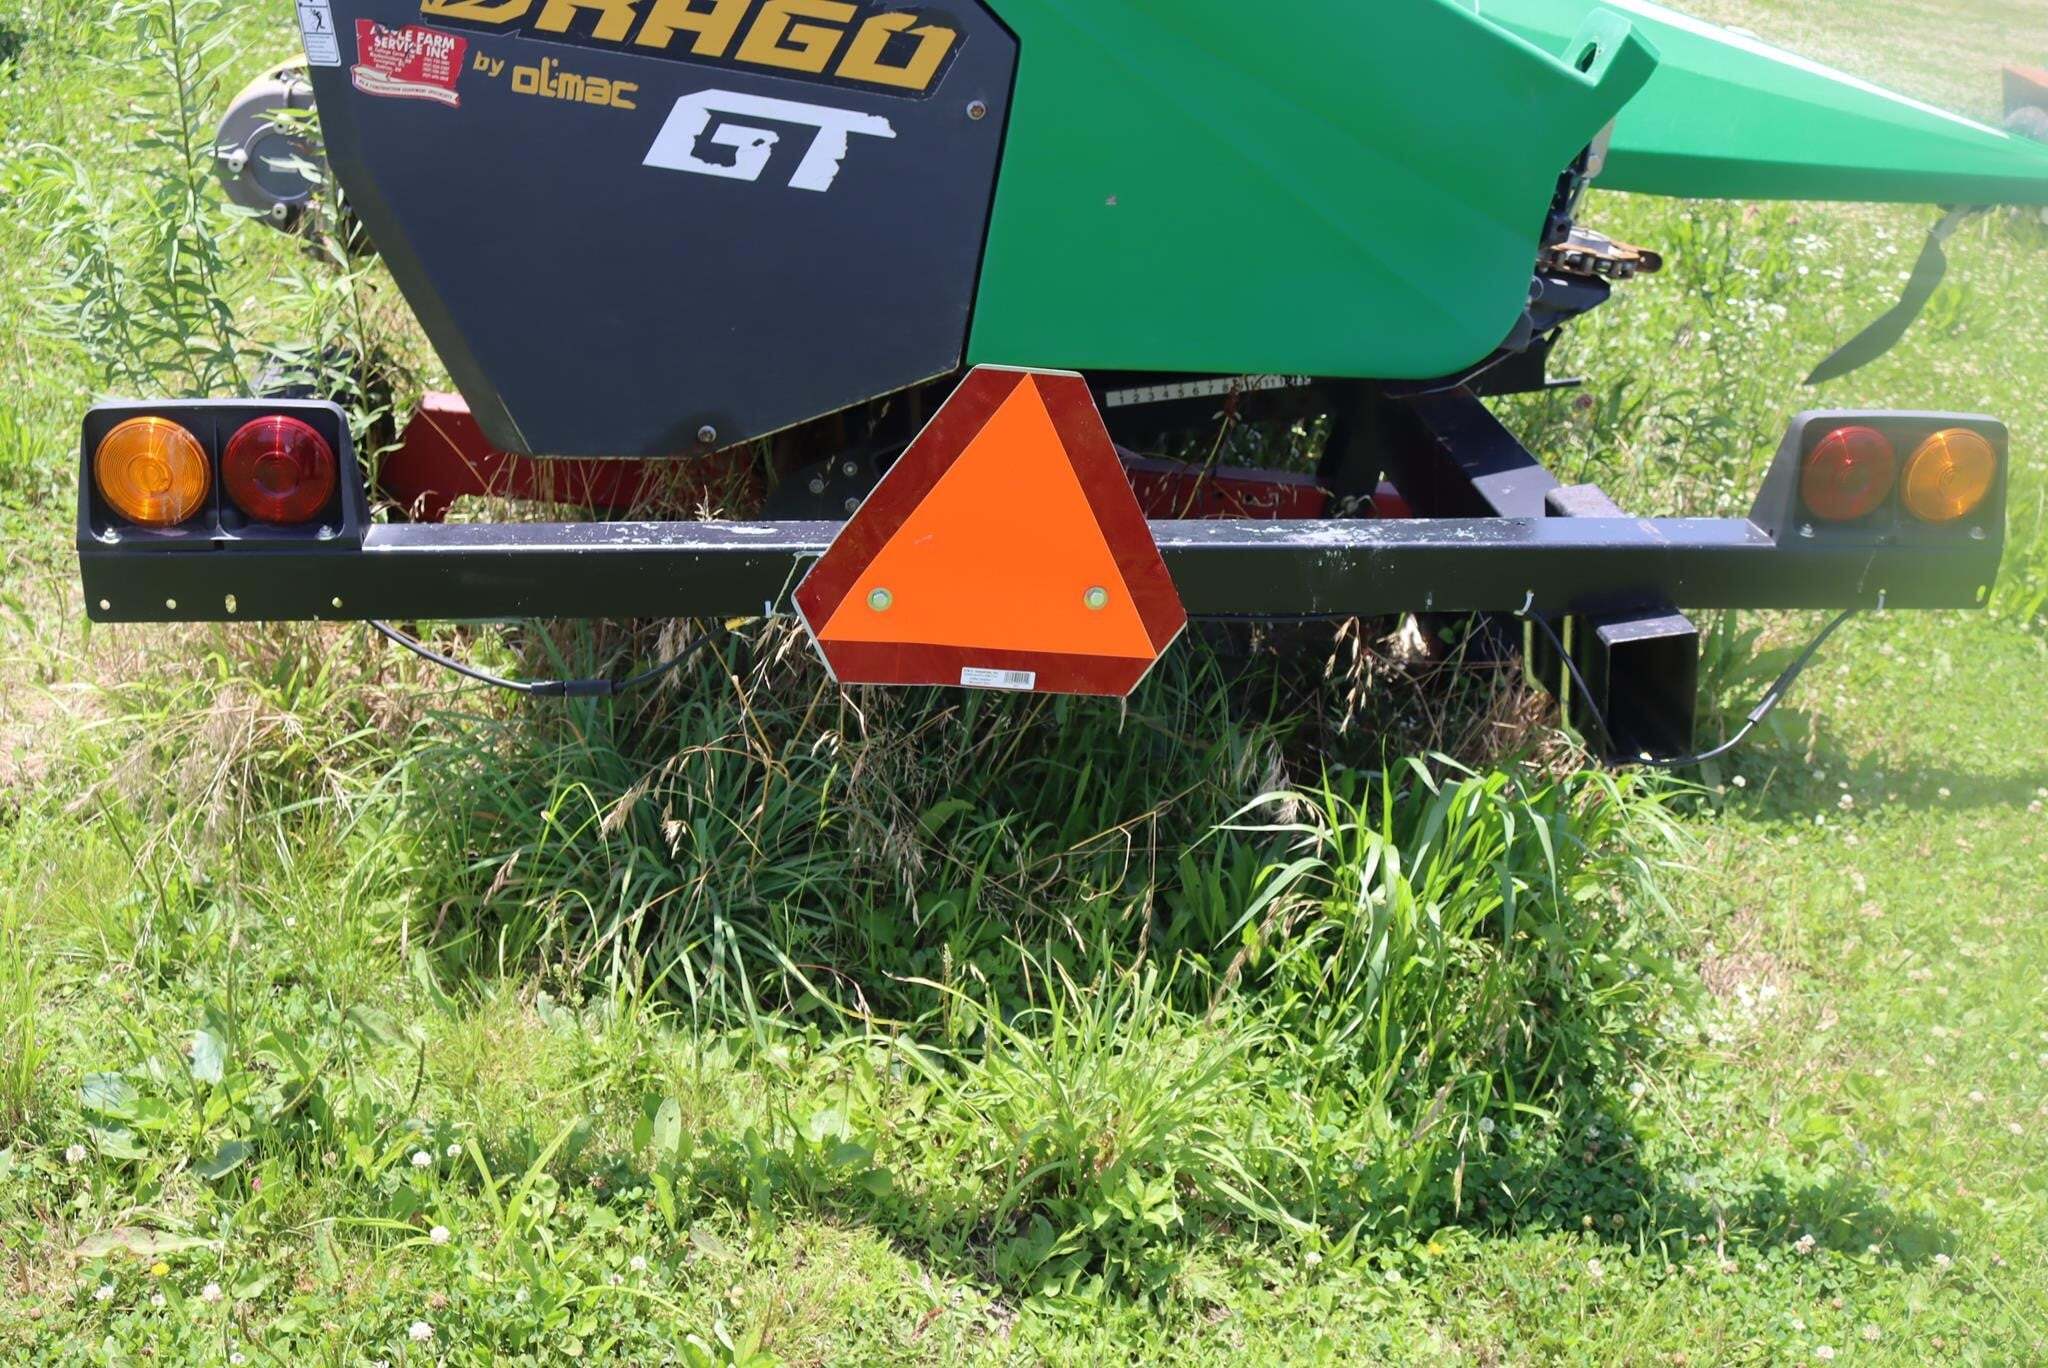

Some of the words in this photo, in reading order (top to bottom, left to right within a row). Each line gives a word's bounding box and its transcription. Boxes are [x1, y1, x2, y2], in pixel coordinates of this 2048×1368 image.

[416, 32, 455, 50] FARM
[420, 0, 957, 91] RAGO
[427, 45, 449, 60] INC
[473, 50, 505, 77] by
[642, 88, 897, 192] GT
